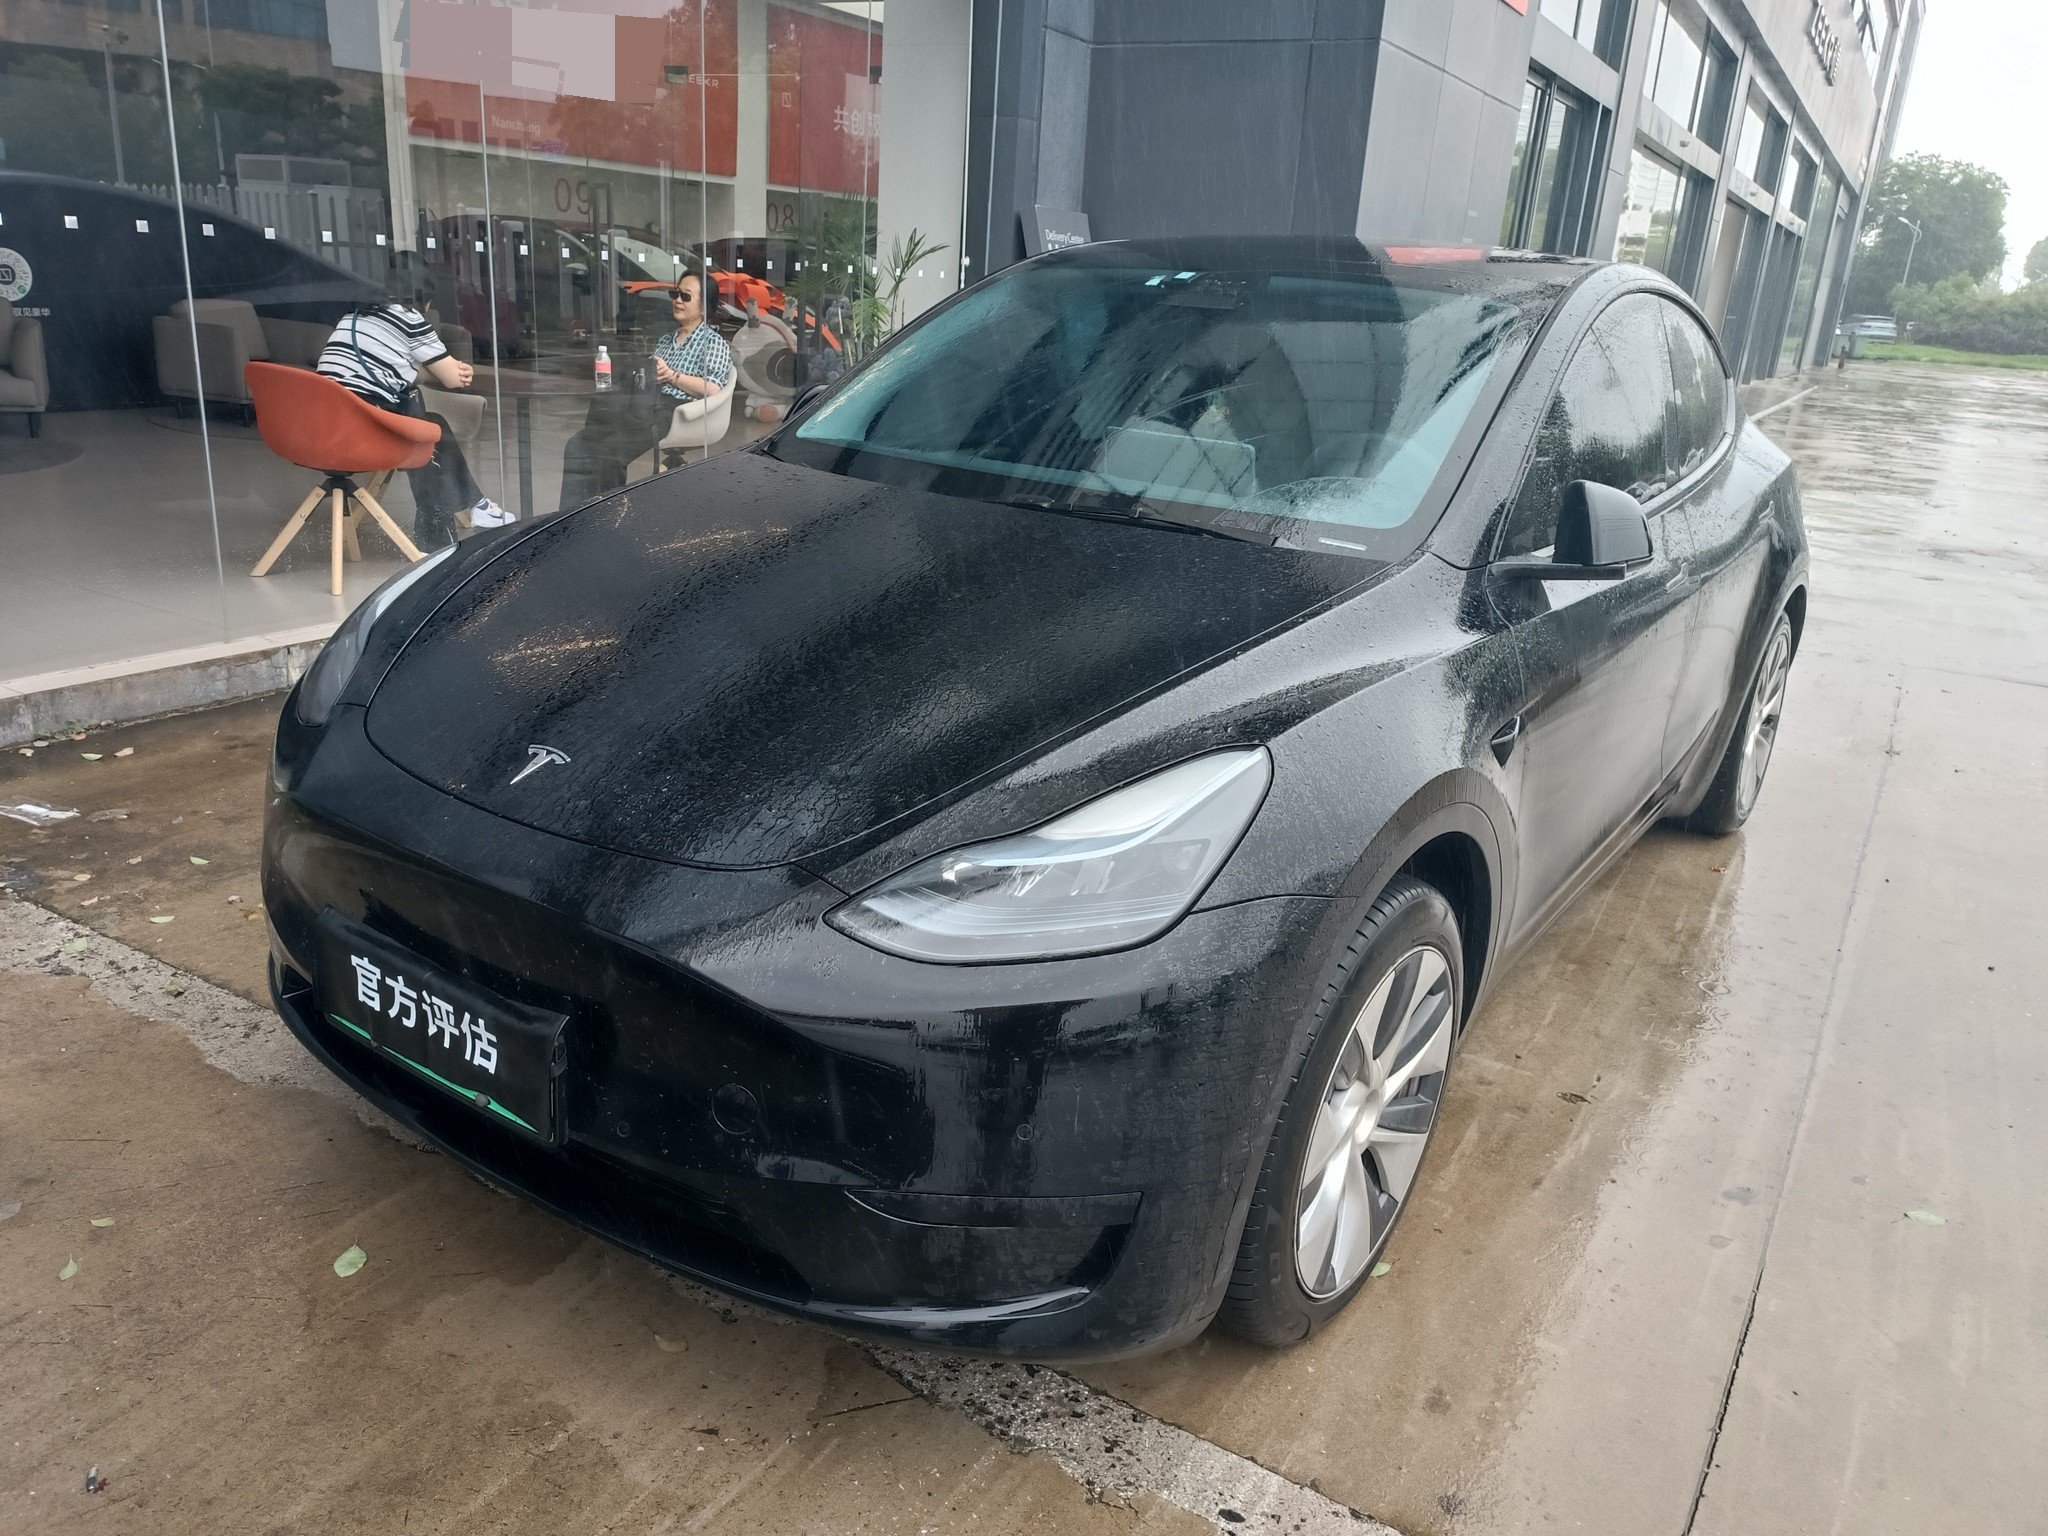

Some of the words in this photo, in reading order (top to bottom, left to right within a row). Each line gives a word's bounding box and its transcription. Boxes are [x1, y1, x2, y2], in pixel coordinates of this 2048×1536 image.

[688, 73, 719, 88] EEKR
[491, 115, 542, 135] Nanchang
[554, 177, 591, 215] 09
[766, 202, 795, 232] 08
[1067, 232, 1085, 244] Center
[350, 954, 498, 1075] 官方评估
